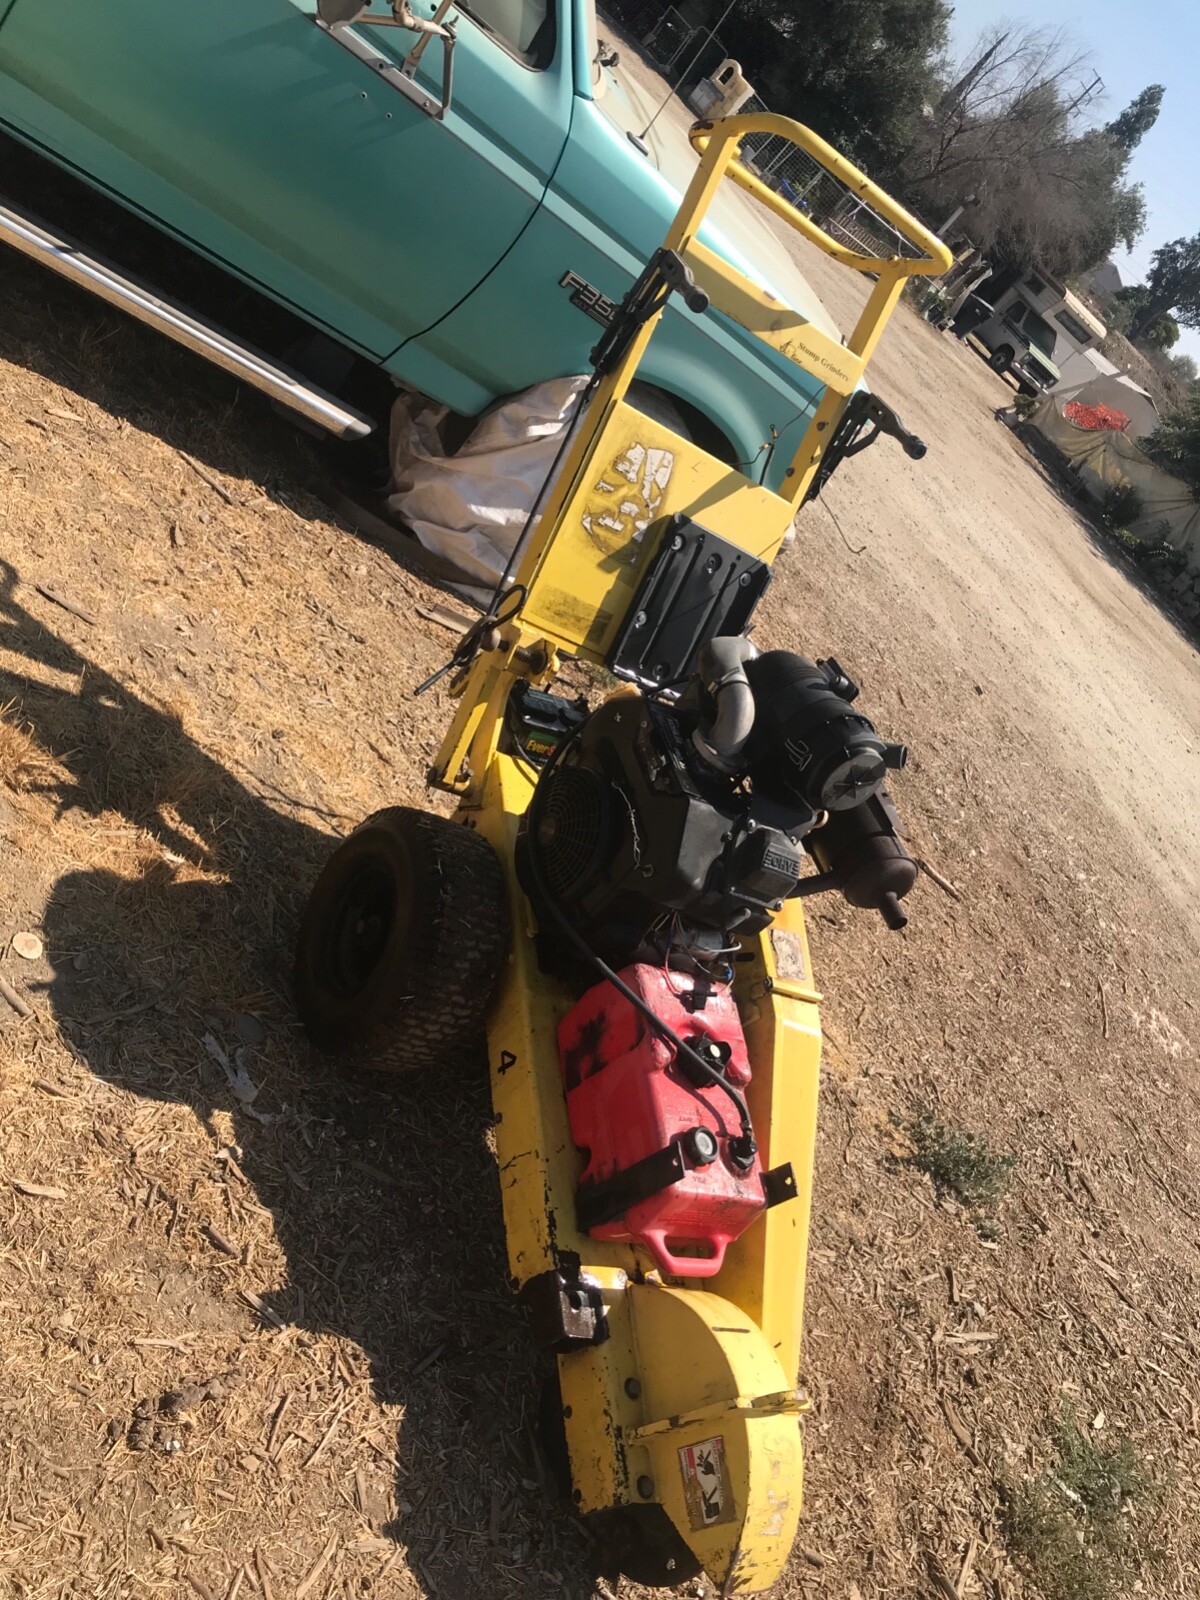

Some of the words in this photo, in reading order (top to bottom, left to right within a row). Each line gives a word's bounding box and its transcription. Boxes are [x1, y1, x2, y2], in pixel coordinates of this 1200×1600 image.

[798, 342, 820, 362] Stump
[820, 357, 849, 382] Grinders
[770, 855, 794, 873] OHV
